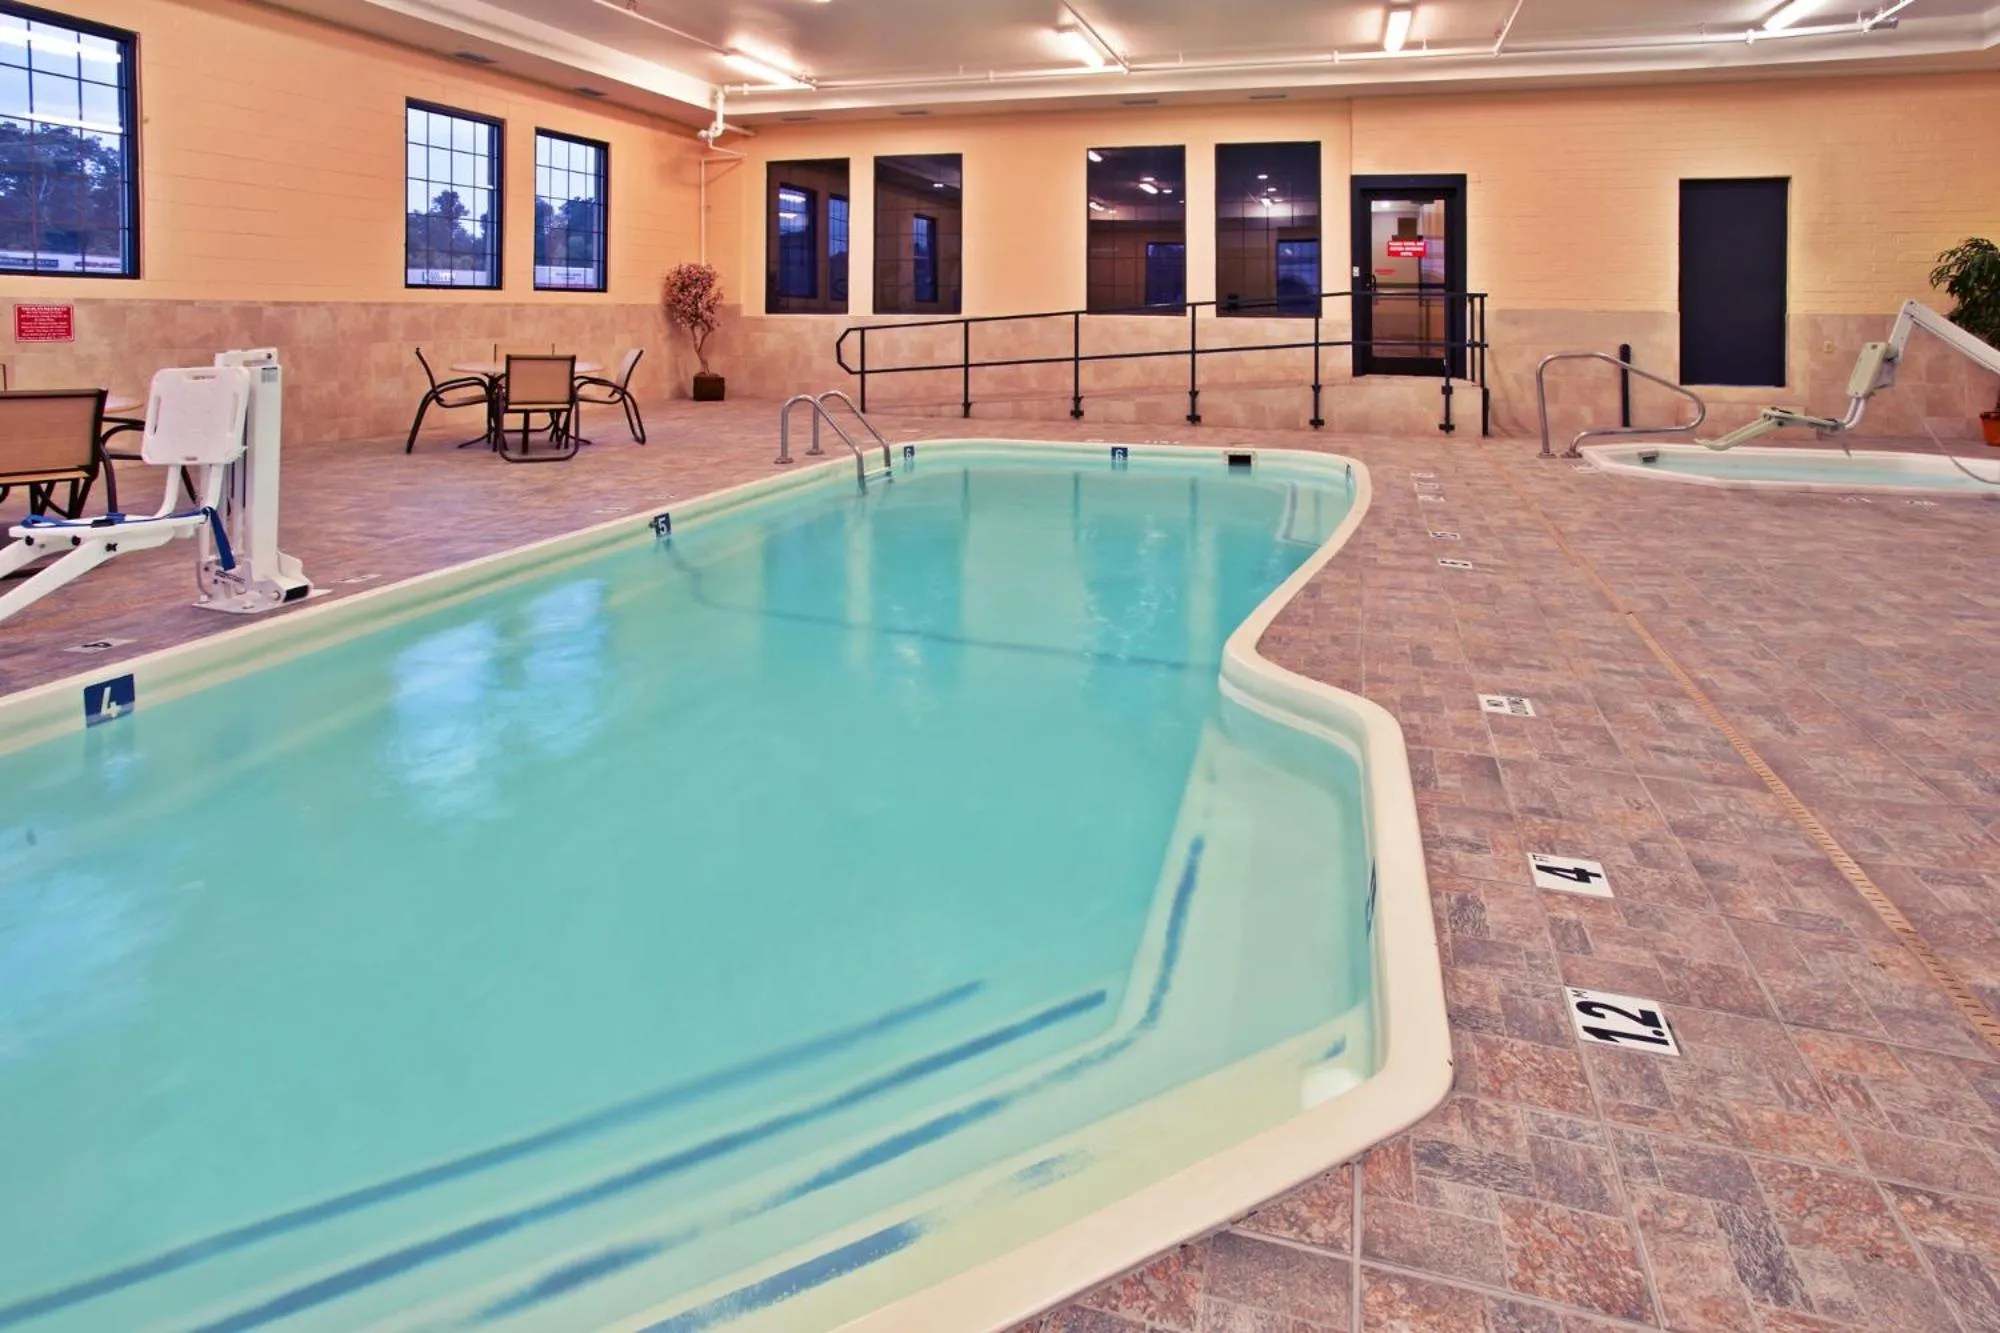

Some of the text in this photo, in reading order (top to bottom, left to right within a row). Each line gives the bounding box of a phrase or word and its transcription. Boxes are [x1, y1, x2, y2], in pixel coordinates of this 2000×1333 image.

[658, 516, 667, 535] 5
[100, 686, 122, 719] 4
[1535, 864, 1602, 884] 4
[1576, 1001, 1670, 1046] 1.2
